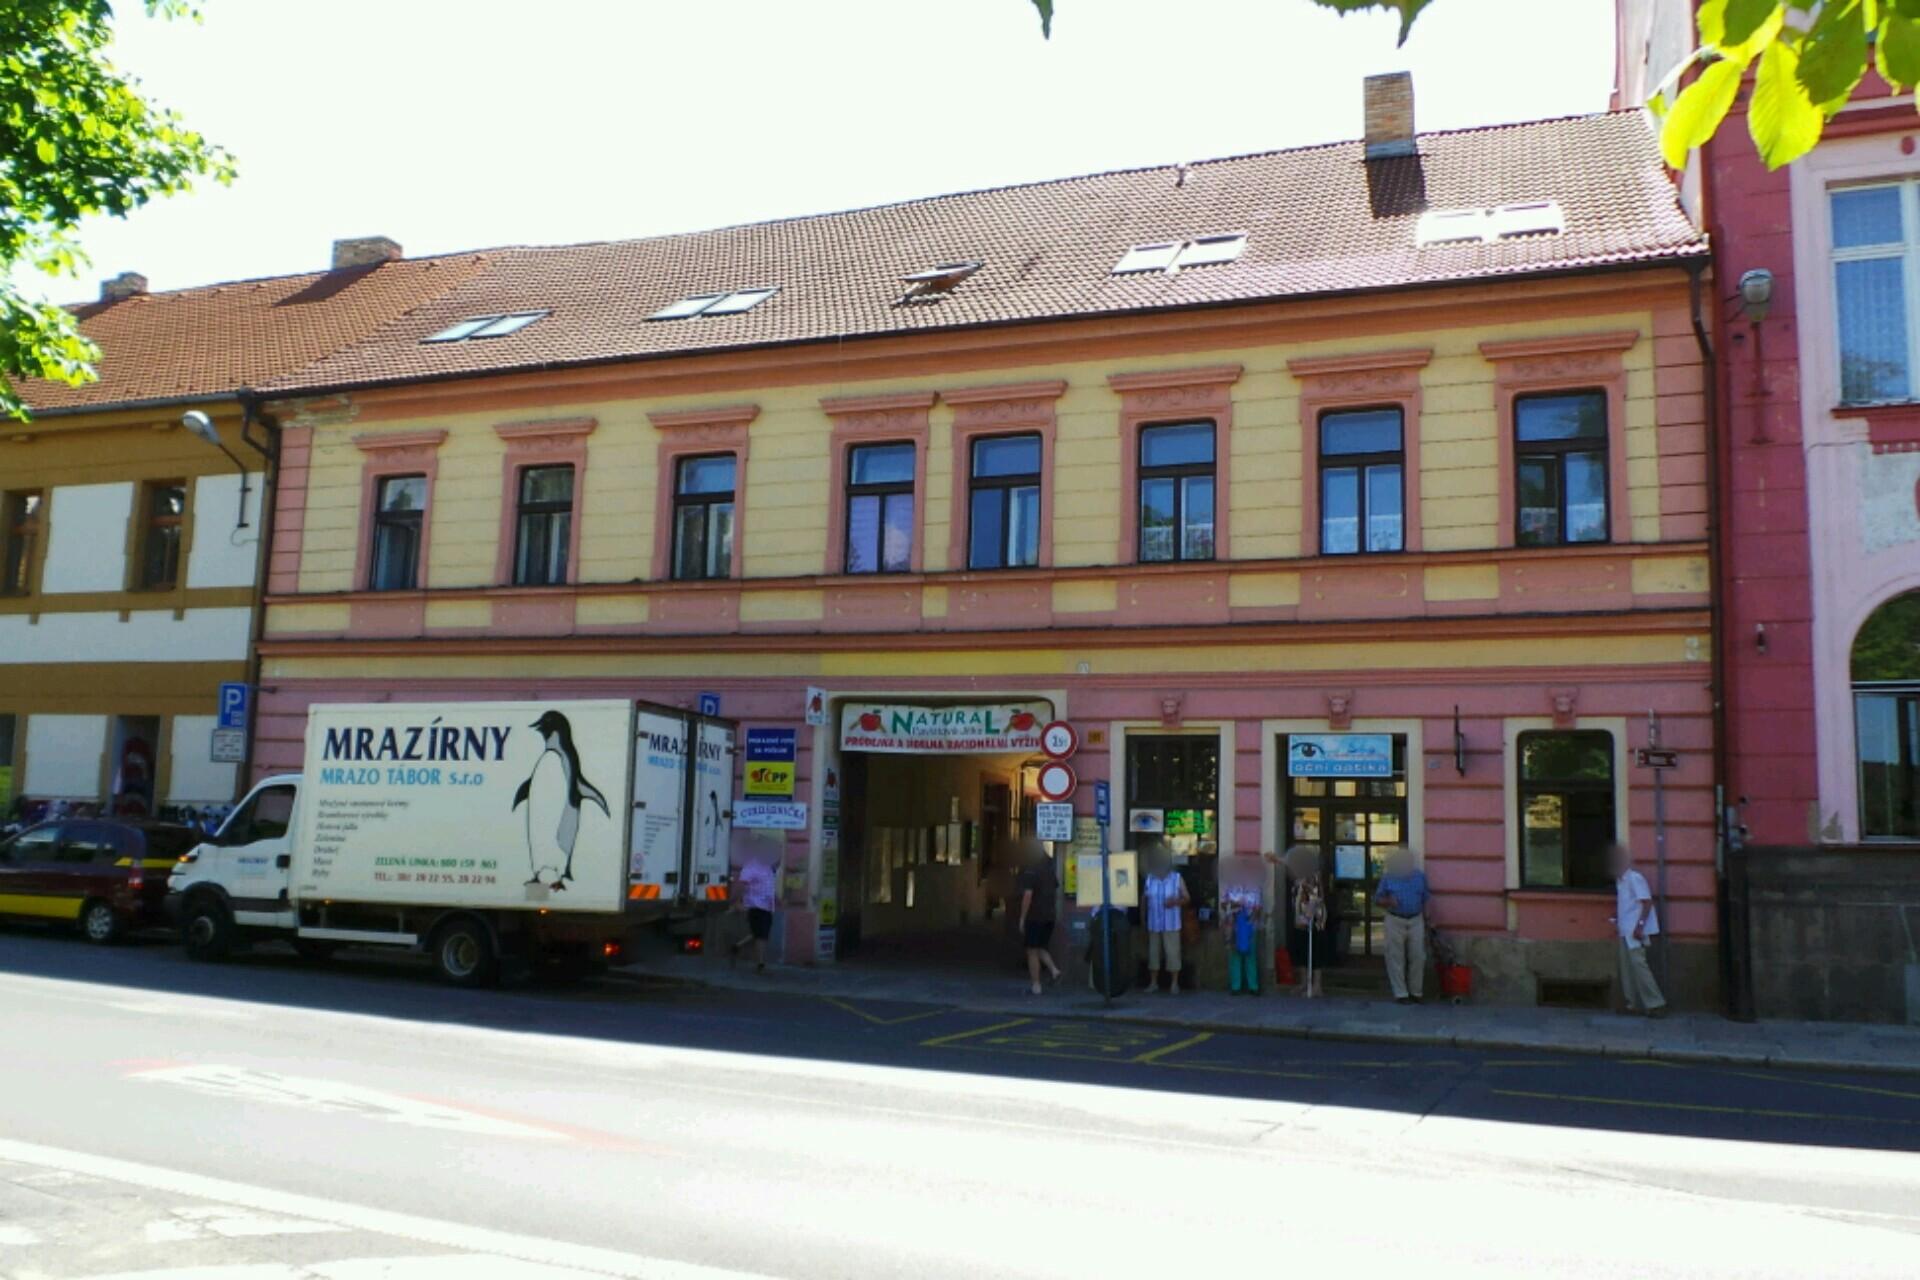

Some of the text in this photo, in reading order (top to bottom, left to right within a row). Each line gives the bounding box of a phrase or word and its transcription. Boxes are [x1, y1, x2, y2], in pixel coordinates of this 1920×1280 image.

[225, 688, 242, 714] P
[892, 709, 1000, 735] NATURAL
[322, 715, 512, 761] MRAZÍRNY
[320, 768, 380, 786] MRAZO
[387, 765, 441, 786] TÁBOR
